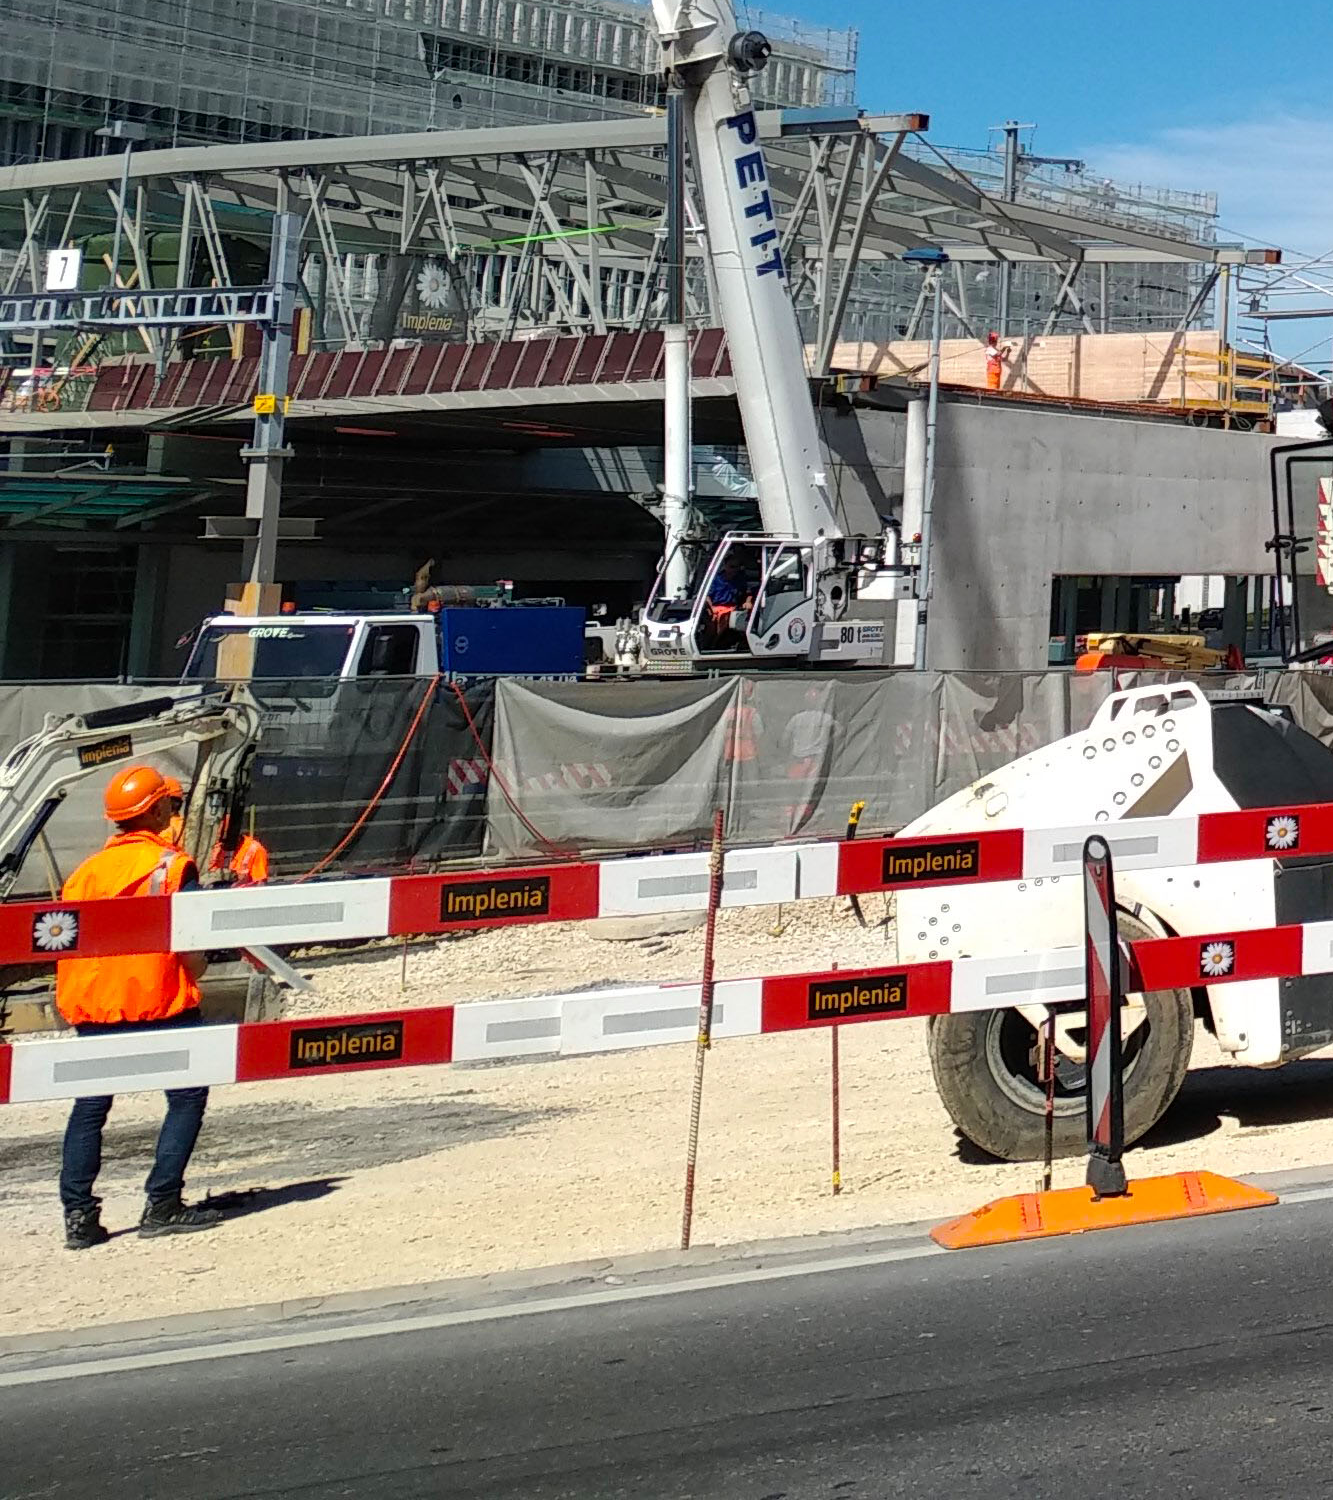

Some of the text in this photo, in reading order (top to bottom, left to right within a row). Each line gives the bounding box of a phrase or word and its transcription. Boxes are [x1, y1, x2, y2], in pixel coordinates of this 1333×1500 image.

[726, 111, 784, 279] PETIT
[60, 256, 69, 282] 7
[403, 312, 453, 333] Implenia
[248, 628, 289, 639] GROVE
[840, 627, 855, 644] 80
[650, 648, 687, 656] GROVE
[889, 850, 975, 879] Implenia
[447, 886, 544, 917] Implenia
[815, 983, 902, 1013] Implenia
[298, 1030, 397, 1062] Implenia
